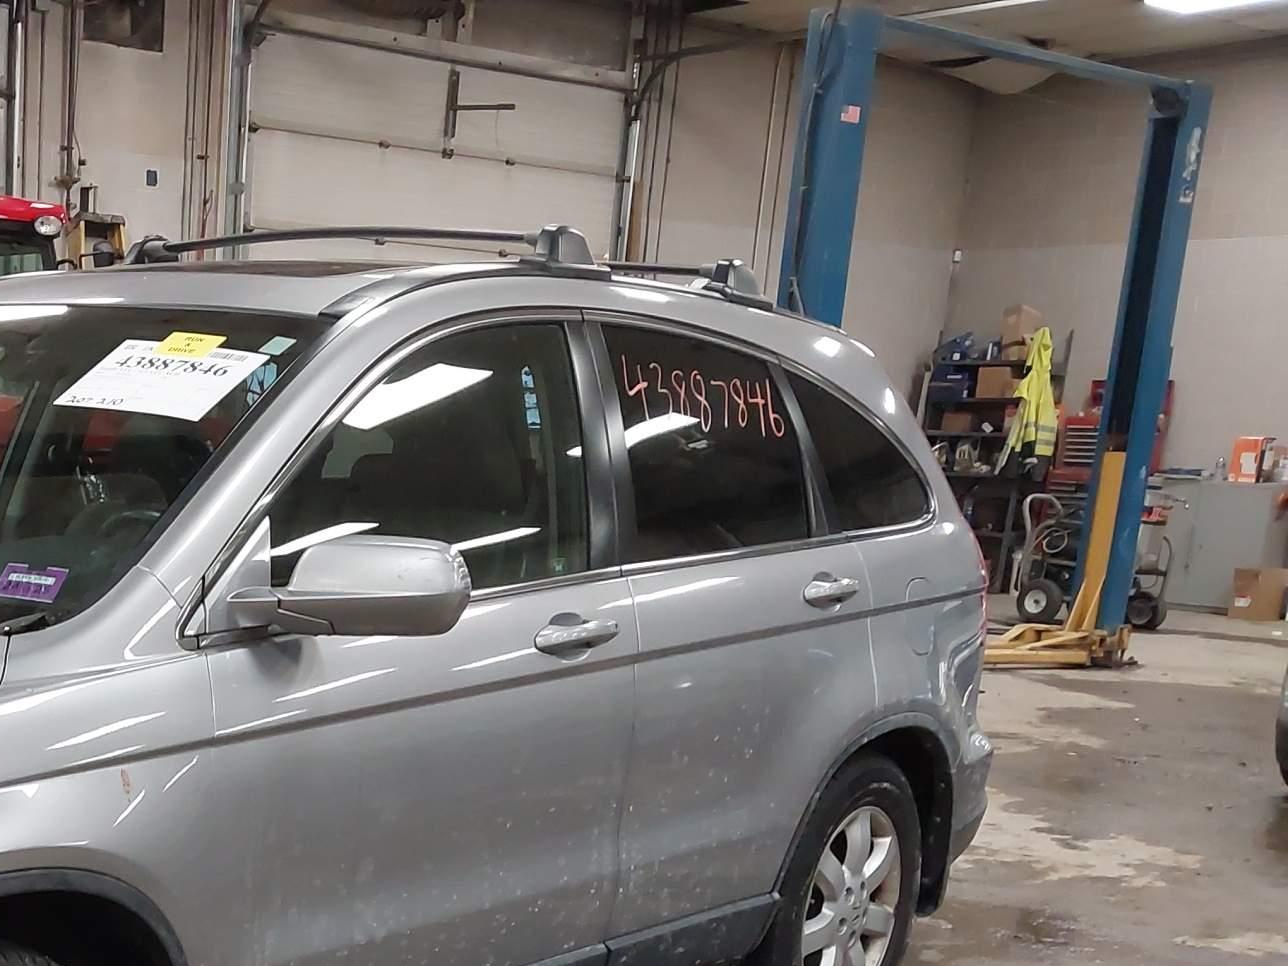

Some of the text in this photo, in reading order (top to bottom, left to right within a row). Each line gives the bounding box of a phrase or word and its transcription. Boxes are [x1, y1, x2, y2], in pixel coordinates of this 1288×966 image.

[167, 346, 197, 354] DRIVE
[114, 354, 230, 378] 43887846
[621, 354, 785, 438] 43887846
